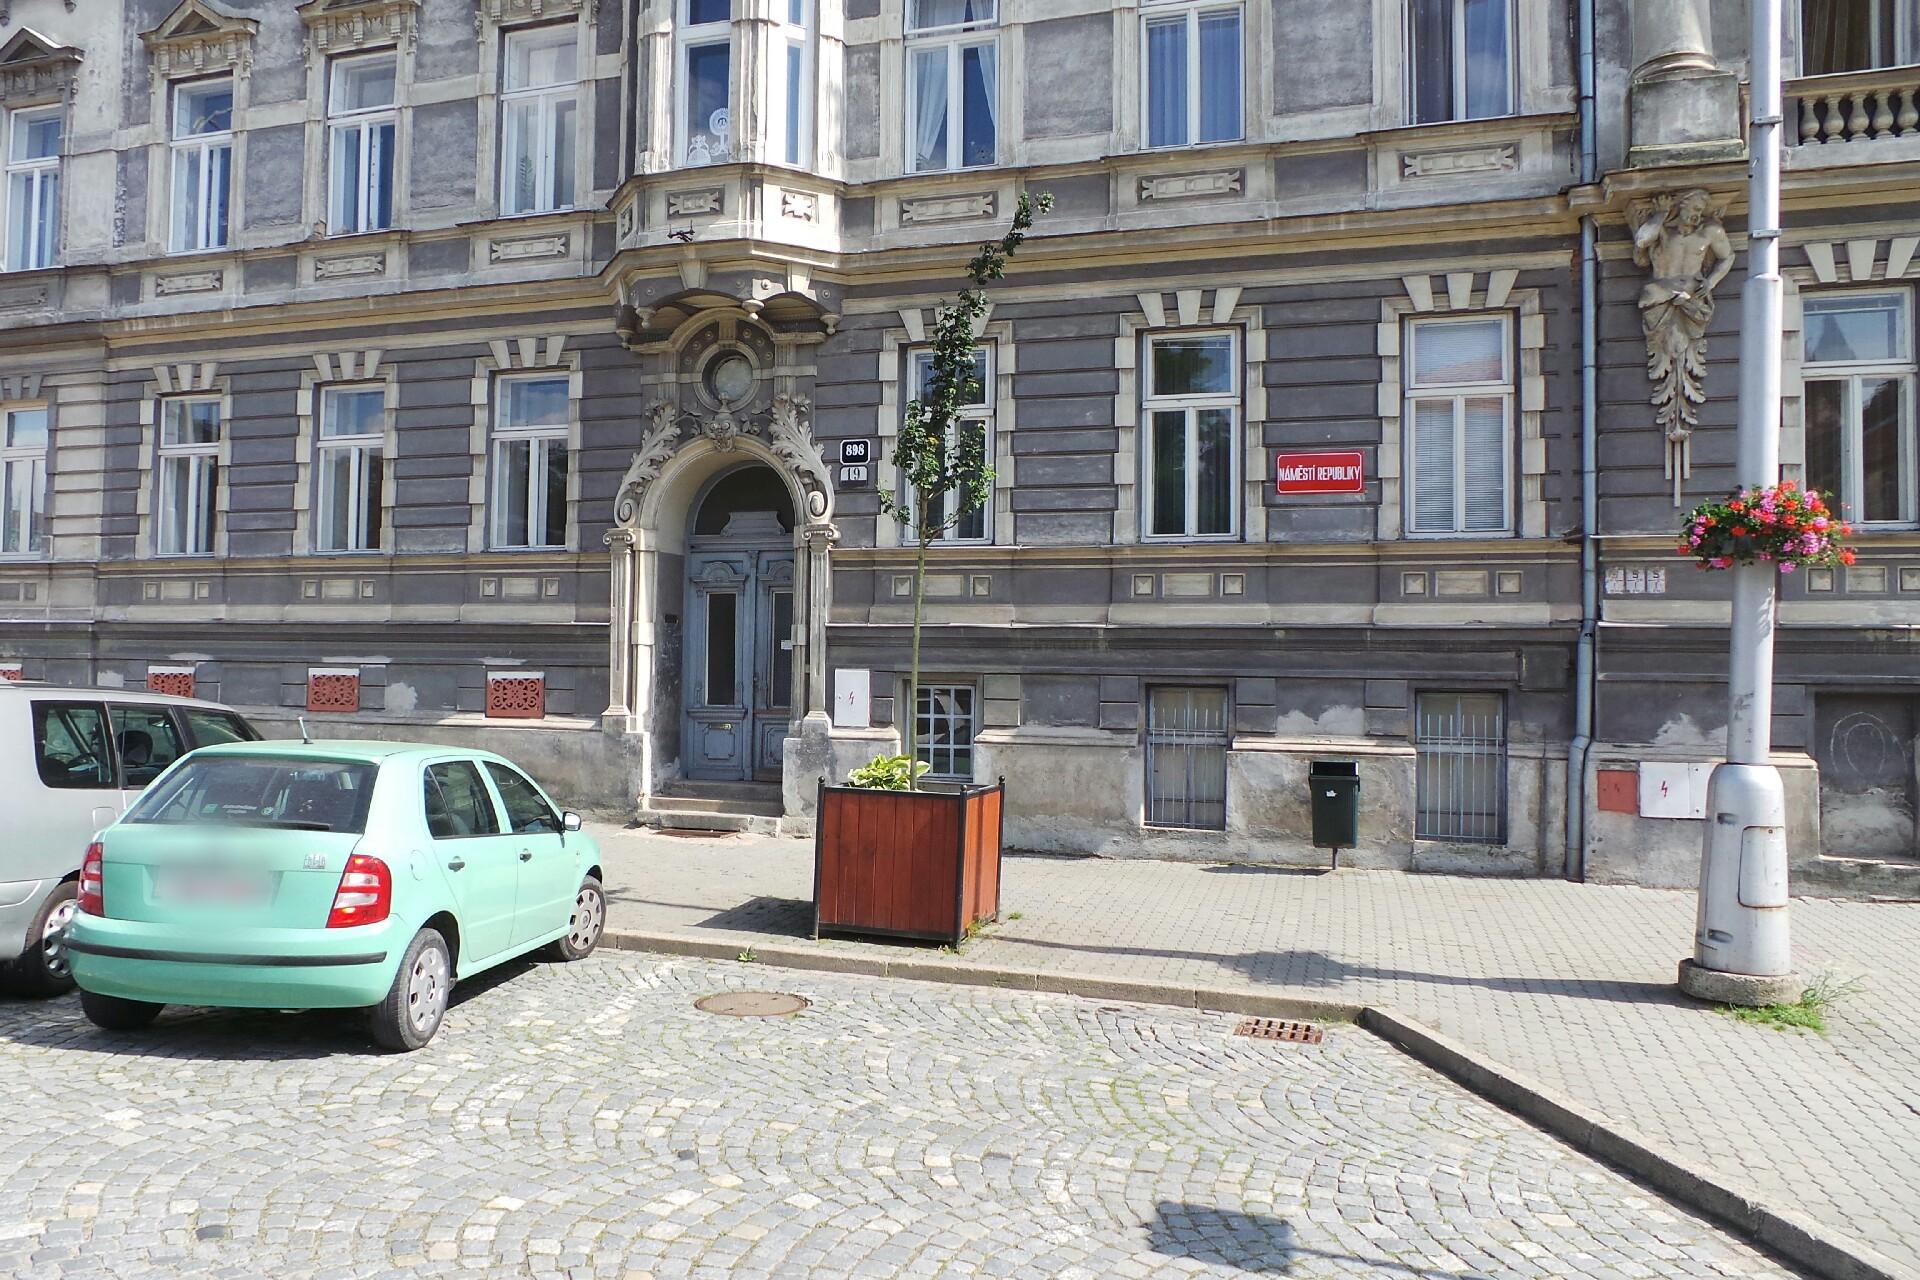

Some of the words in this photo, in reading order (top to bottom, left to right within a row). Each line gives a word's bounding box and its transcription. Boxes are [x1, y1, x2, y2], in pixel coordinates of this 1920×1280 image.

[846, 444, 865, 456] 898
[848, 467, 860, 480] 19
[1280, 465, 1316, 481] NÁMĚSTÍ
[1317, 466, 1361, 481] REPUBLIKY
